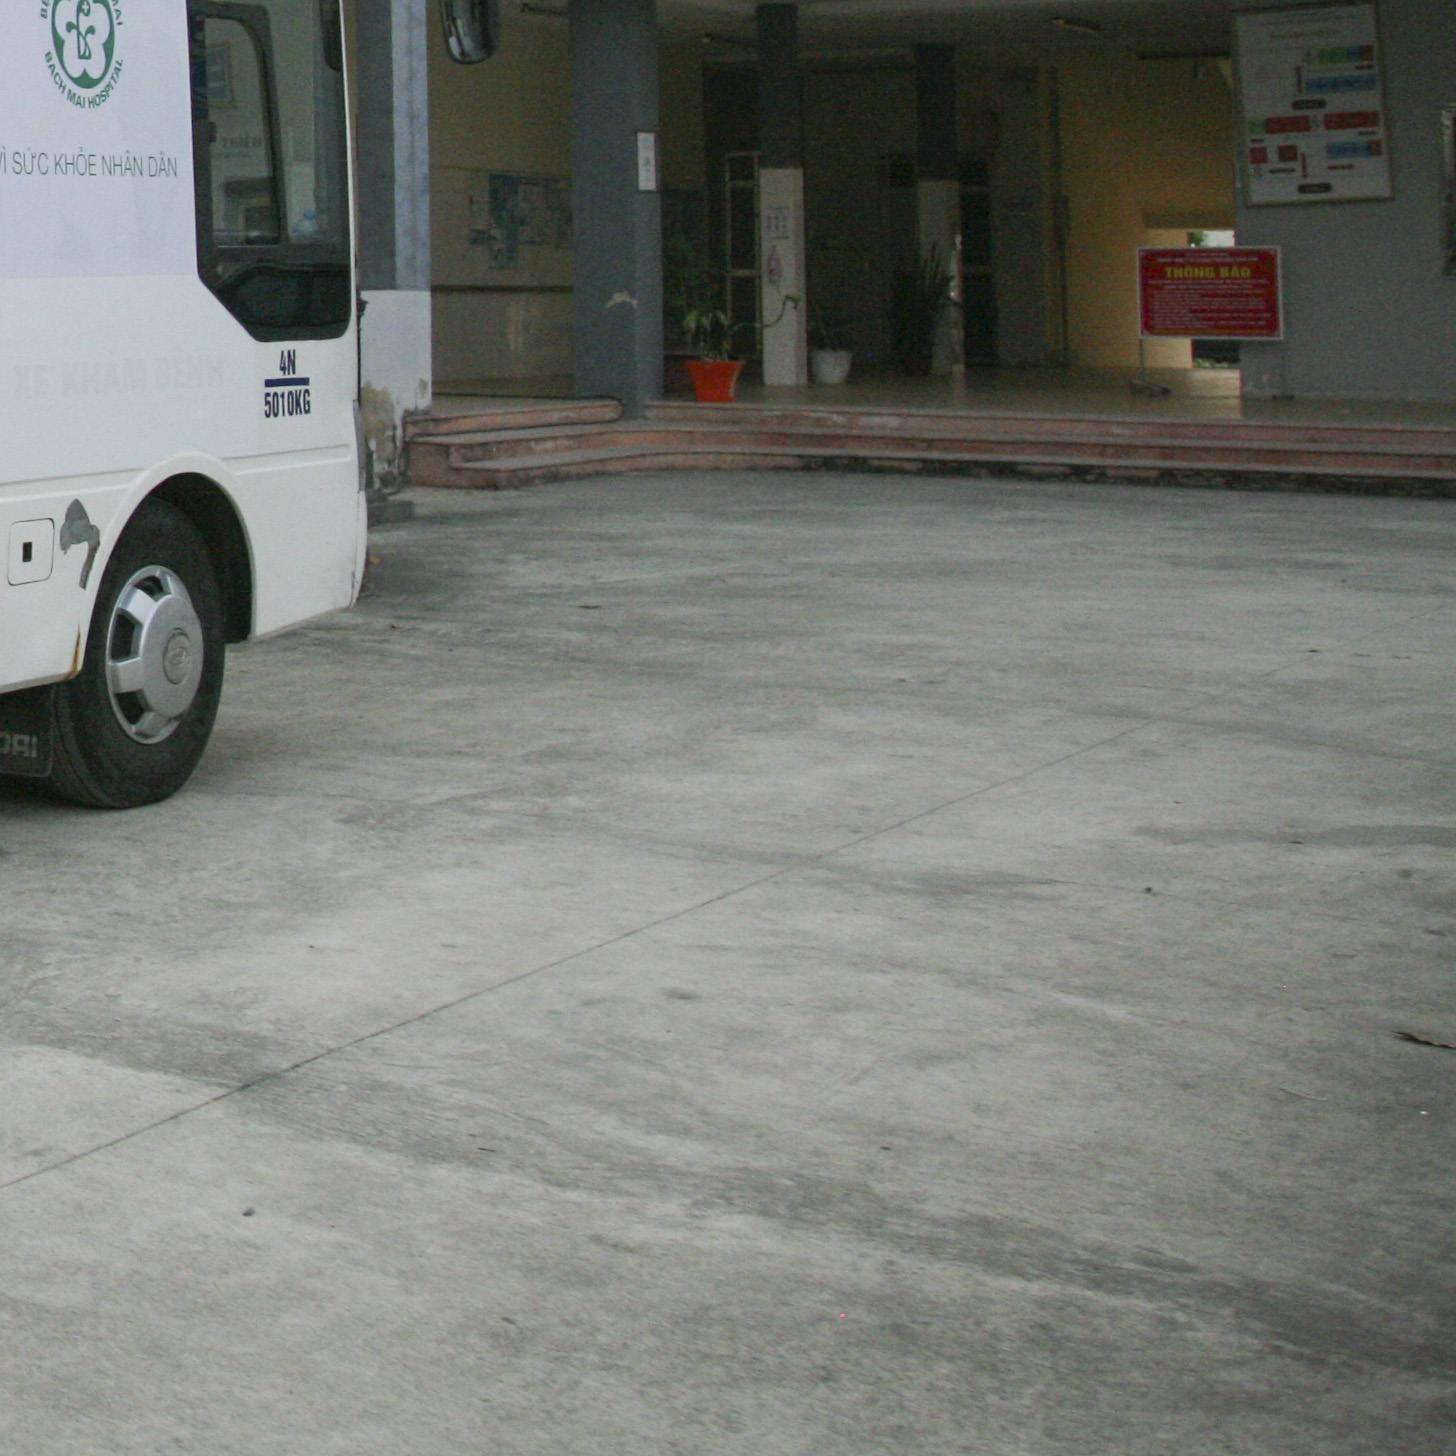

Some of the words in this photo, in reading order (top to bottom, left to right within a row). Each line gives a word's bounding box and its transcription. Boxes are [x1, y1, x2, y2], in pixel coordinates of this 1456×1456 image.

[44, 51, 67, 95] BACH
[66, 88, 86, 109] MAI
[88, 59, 124, 109] HOSPITAL
[12, 147, 49, 175] SỨC
[54, 146, 97, 176] KHỎE
[101, 150, 144, 177] NHÂN
[148, 151, 178, 177] DÂN
[279, 349, 296, 376] 4N
[264, 388, 311, 419] 5010KG
